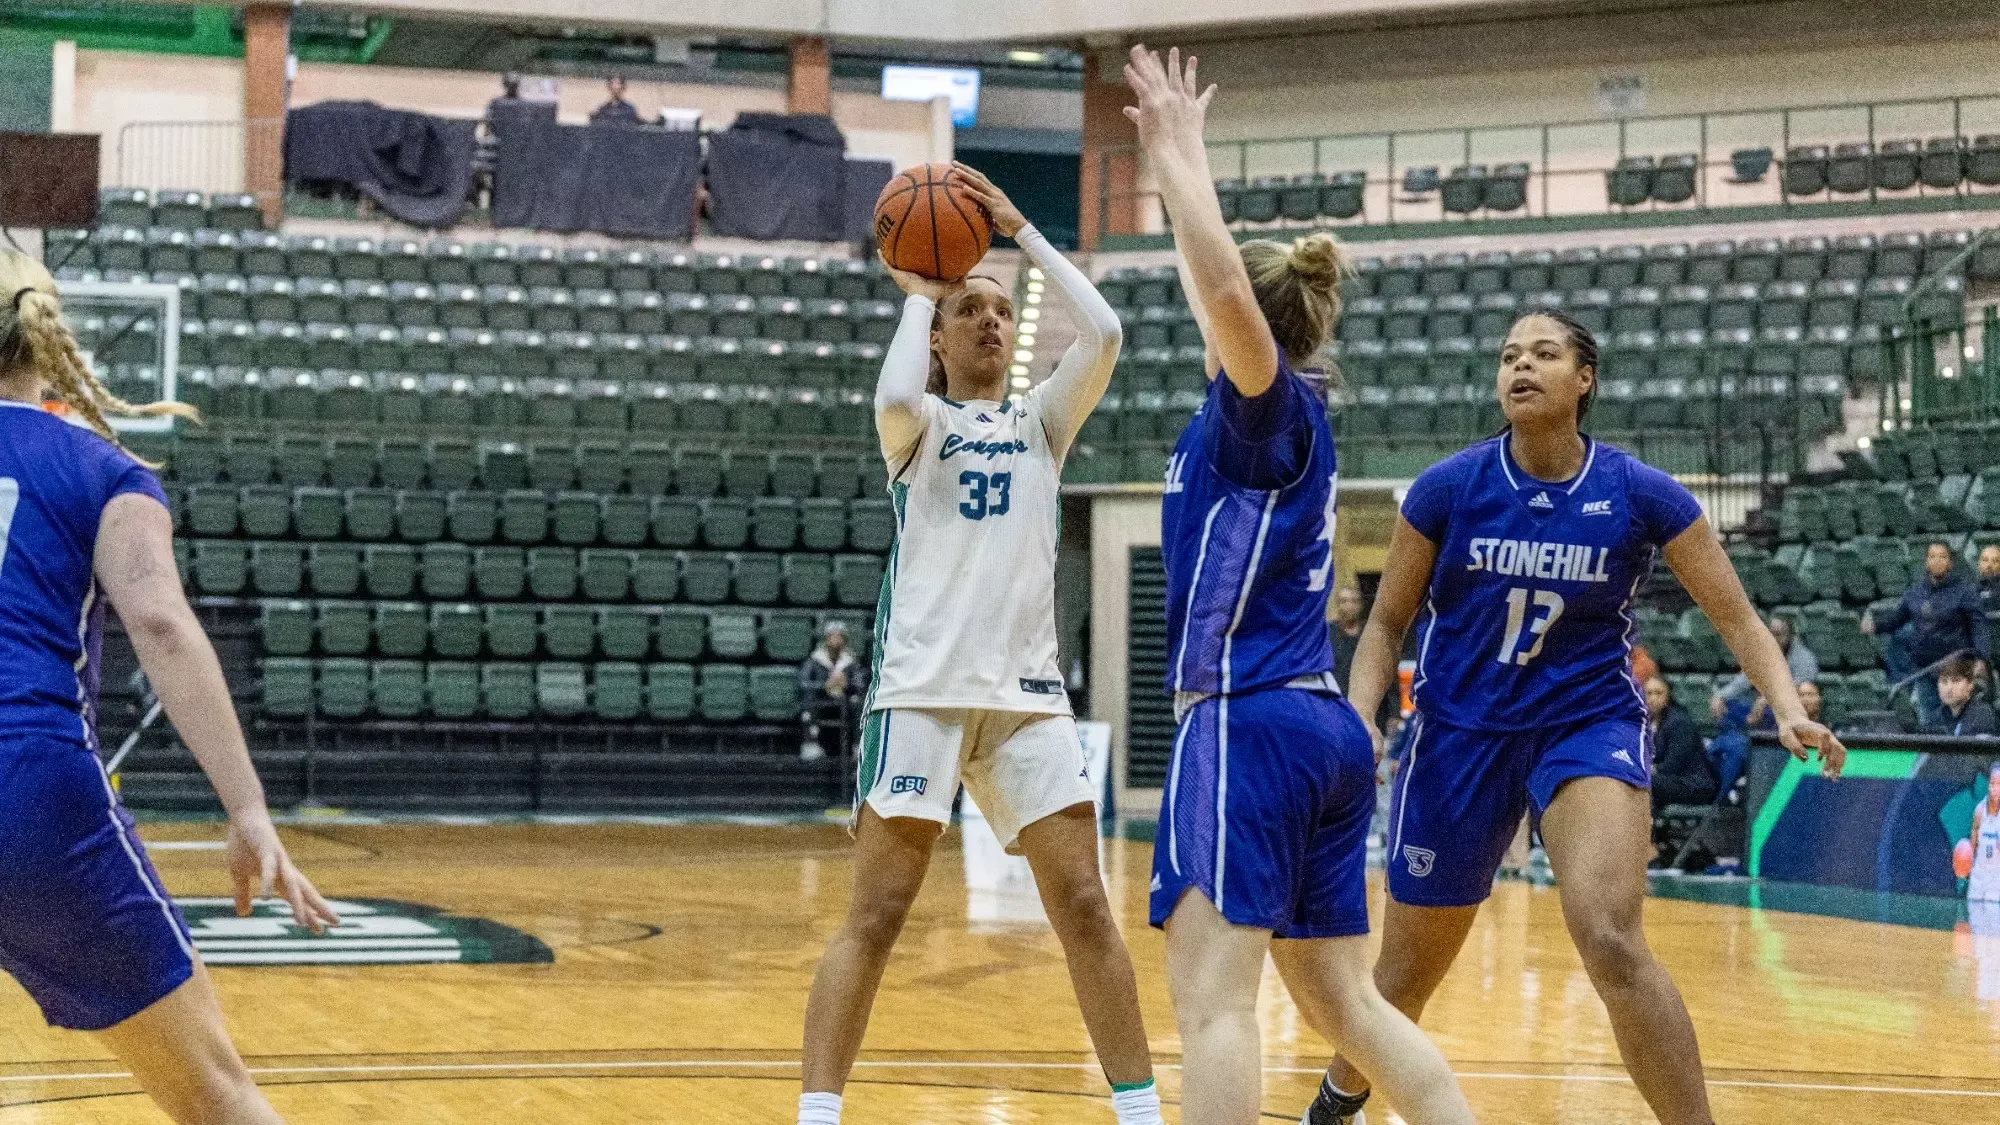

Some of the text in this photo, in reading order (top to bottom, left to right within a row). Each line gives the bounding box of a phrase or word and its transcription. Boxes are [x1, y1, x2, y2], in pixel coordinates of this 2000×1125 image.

[939, 433, 1028, 460] Cougars
[959, 470, 1012, 521] 33
[1581, 500, 1611, 513] NEC
[1466, 537, 1610, 582] STONEHILL
[1497, 587, 1565, 666] 13
[891, 776, 928, 795] CSU
